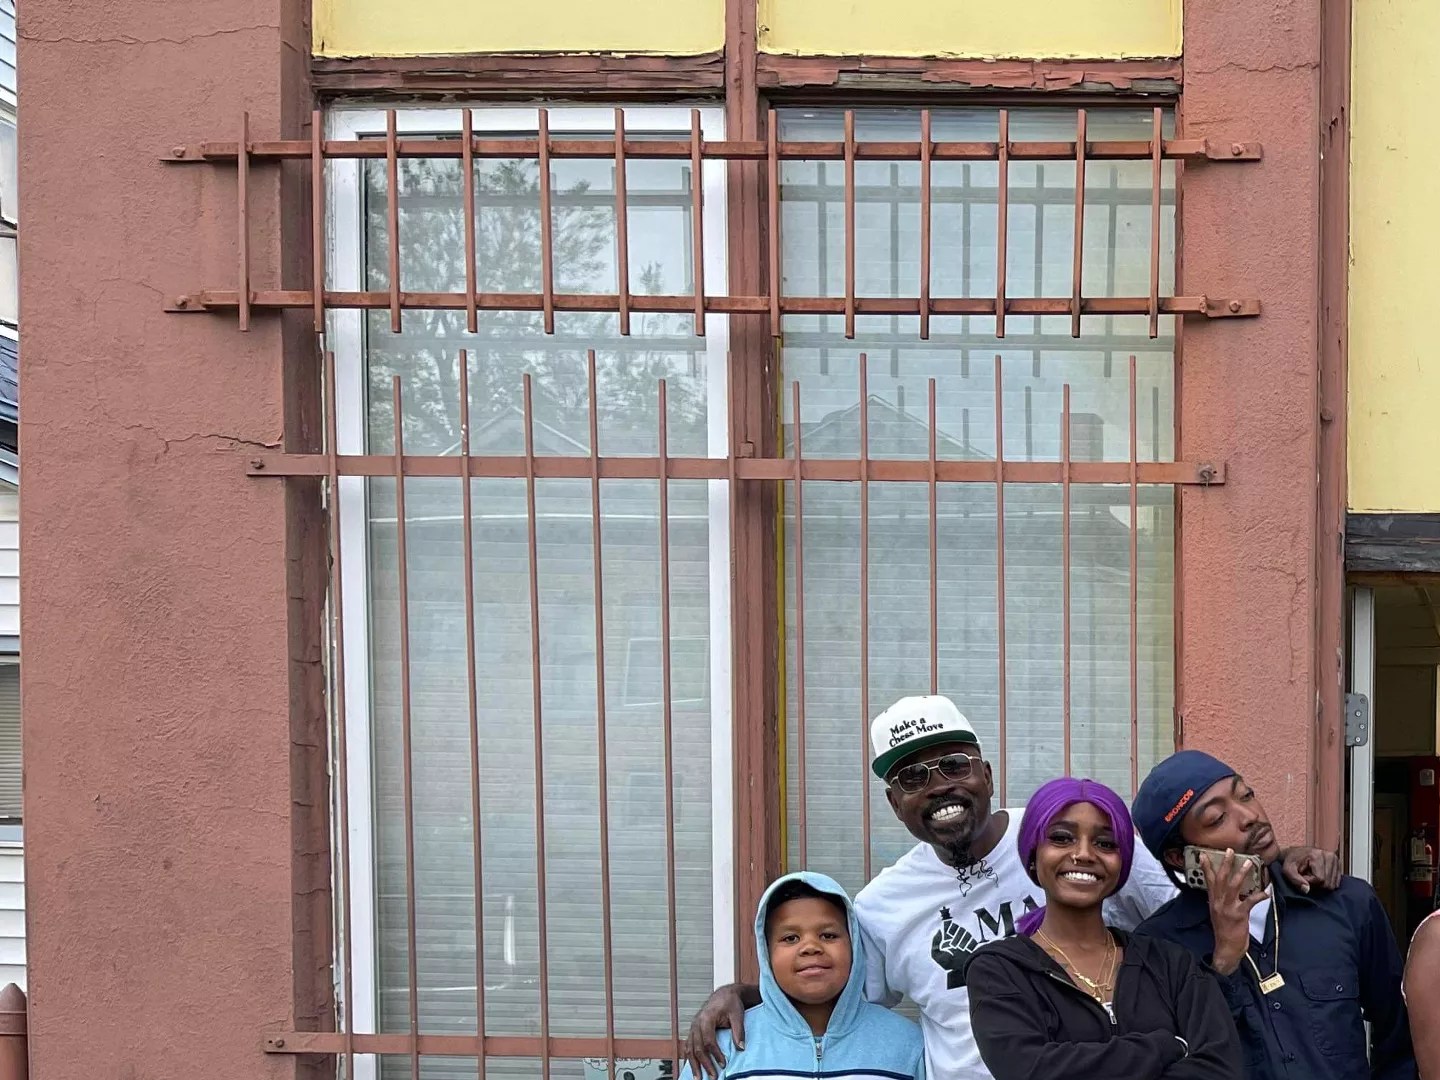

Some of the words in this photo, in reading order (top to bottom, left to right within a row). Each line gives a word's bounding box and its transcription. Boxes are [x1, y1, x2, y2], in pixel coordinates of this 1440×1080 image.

[888, 730, 915, 748] Chess
[916, 723, 944, 736] Move
[889, 718, 917, 736] Make
[919, 717, 927, 725] a
[1164, 789, 1194, 822] BRONCOS
